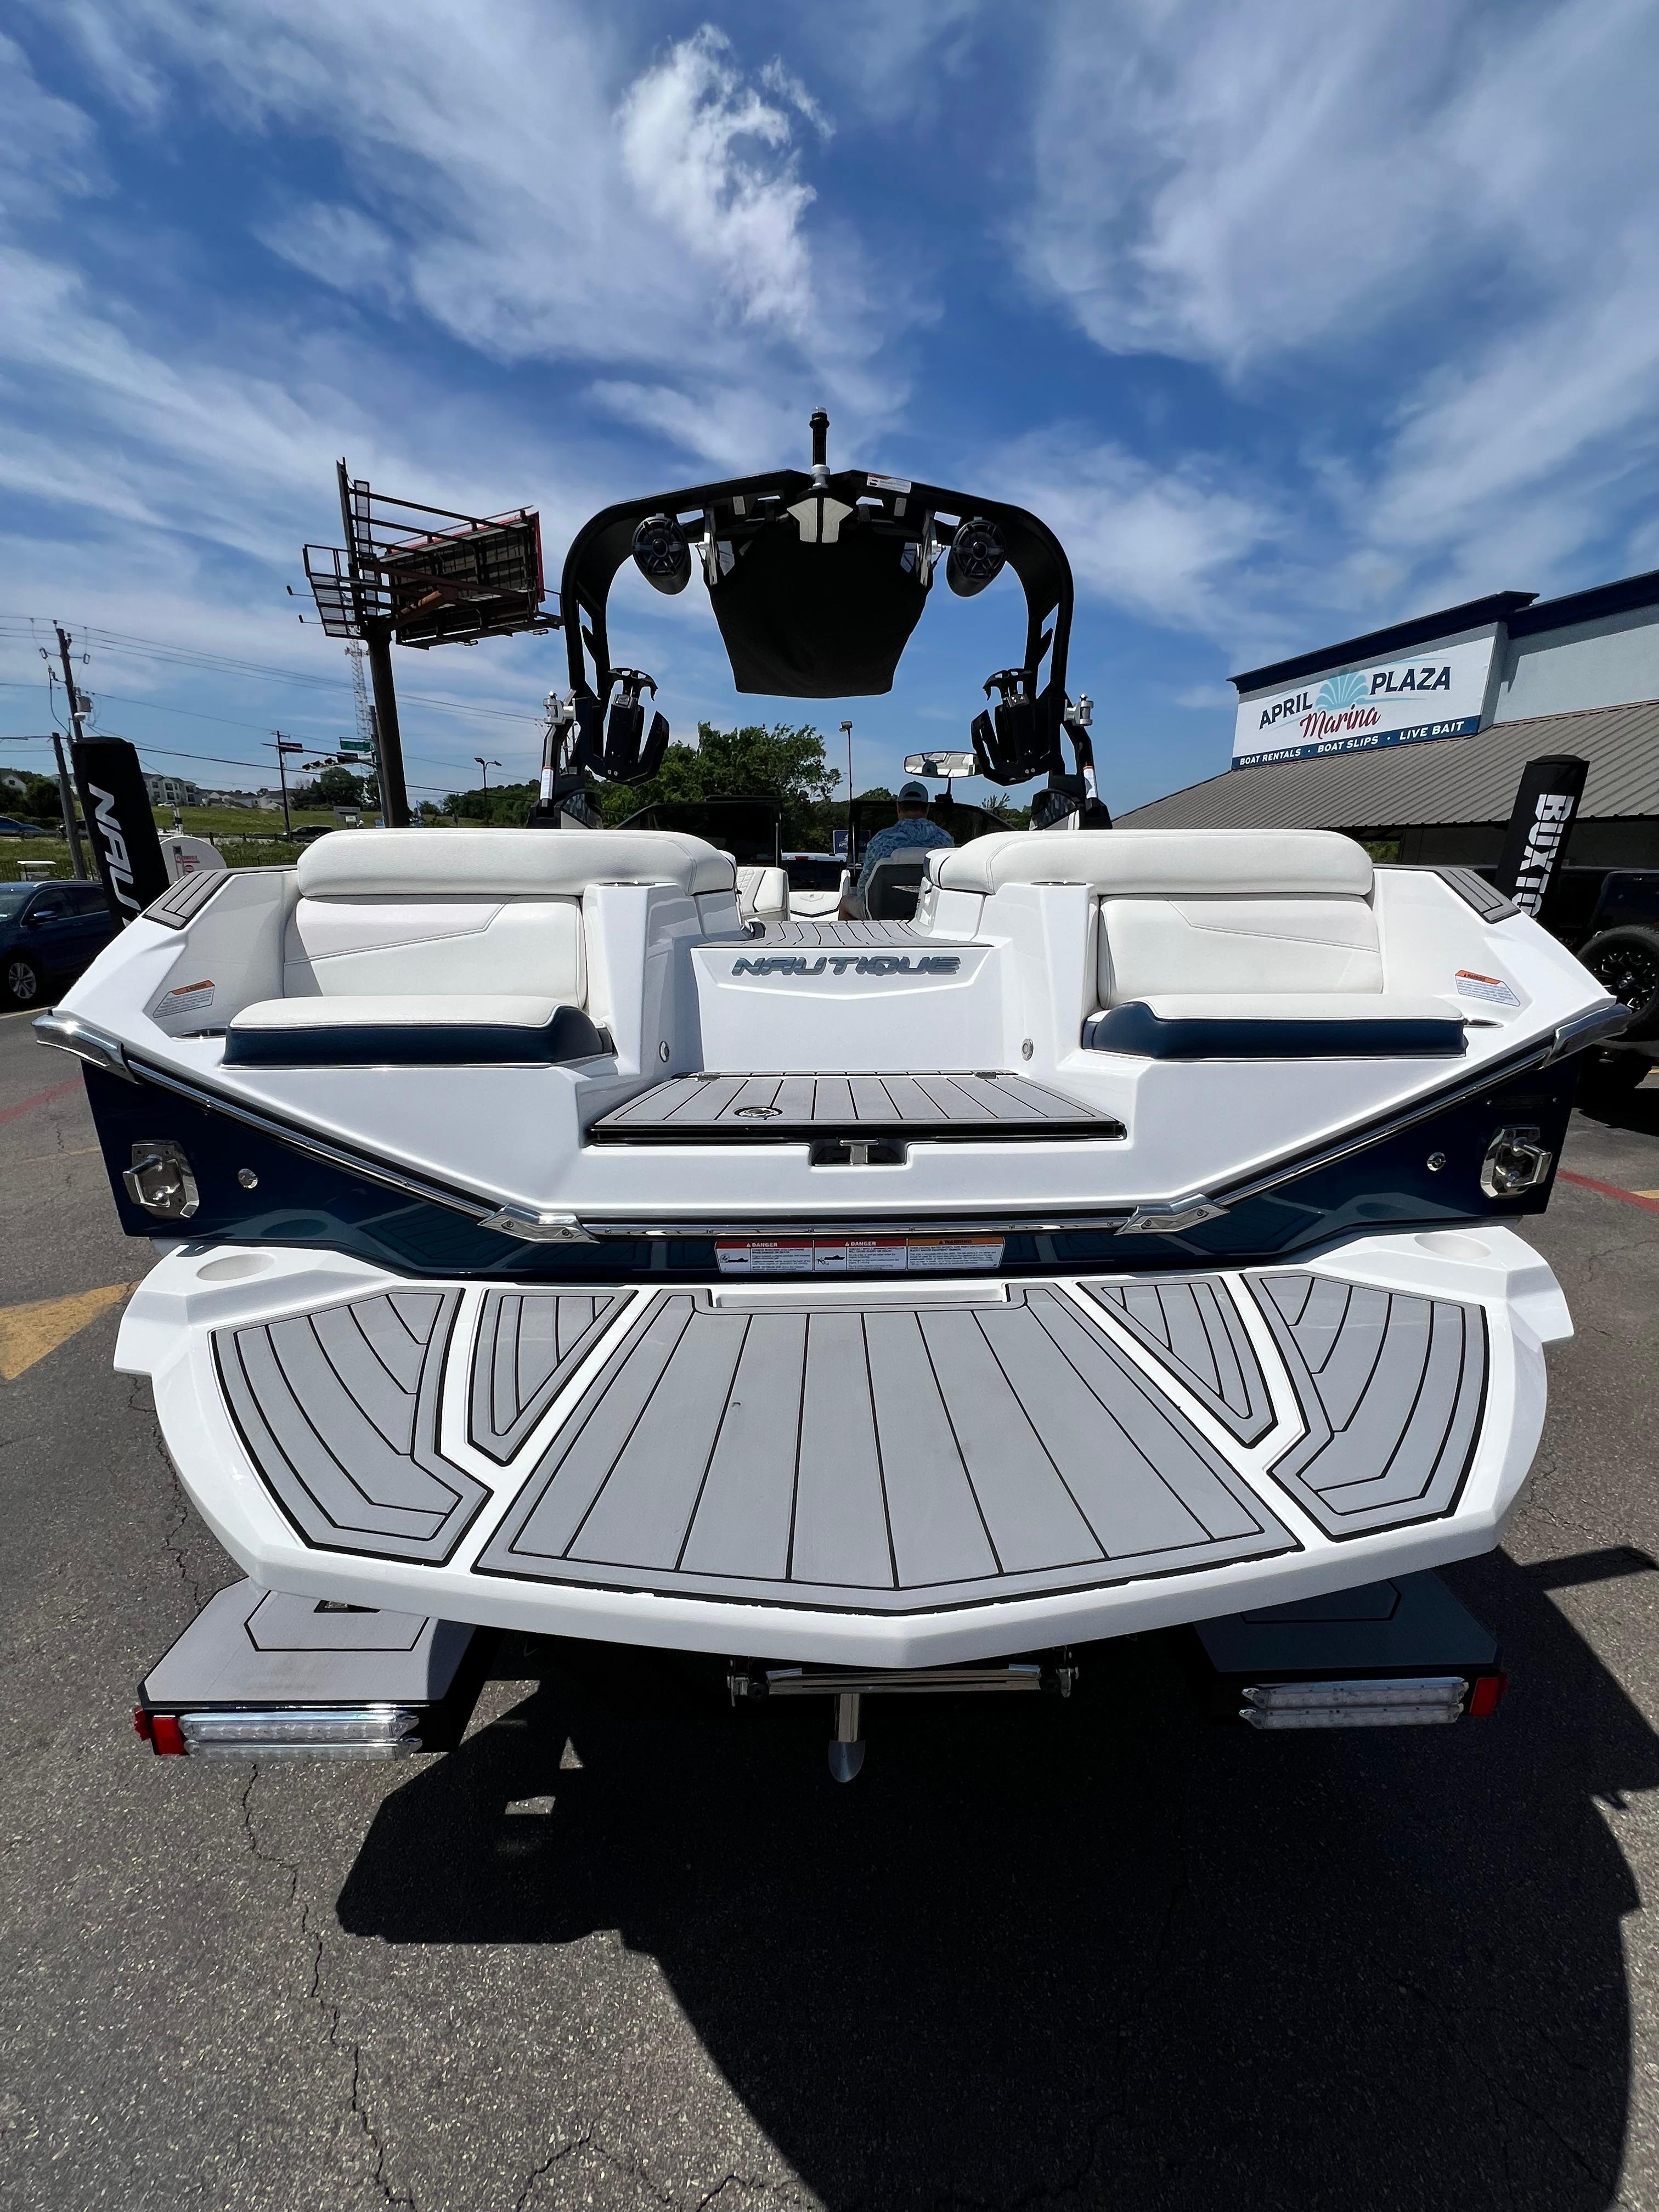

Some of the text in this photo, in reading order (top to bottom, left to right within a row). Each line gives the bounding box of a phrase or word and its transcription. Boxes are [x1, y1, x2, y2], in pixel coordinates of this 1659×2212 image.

[1259, 667, 1451, 730] APRIL PLAZA
[1240, 721, 1465, 765] BOAT RENTALS BOAT SLIPS LIVE BAIT
[1300, 704, 1381, 740] Marina
[1512, 794, 1574, 919] BUXTO
[731, 956, 961, 976] NAUTIQUE
